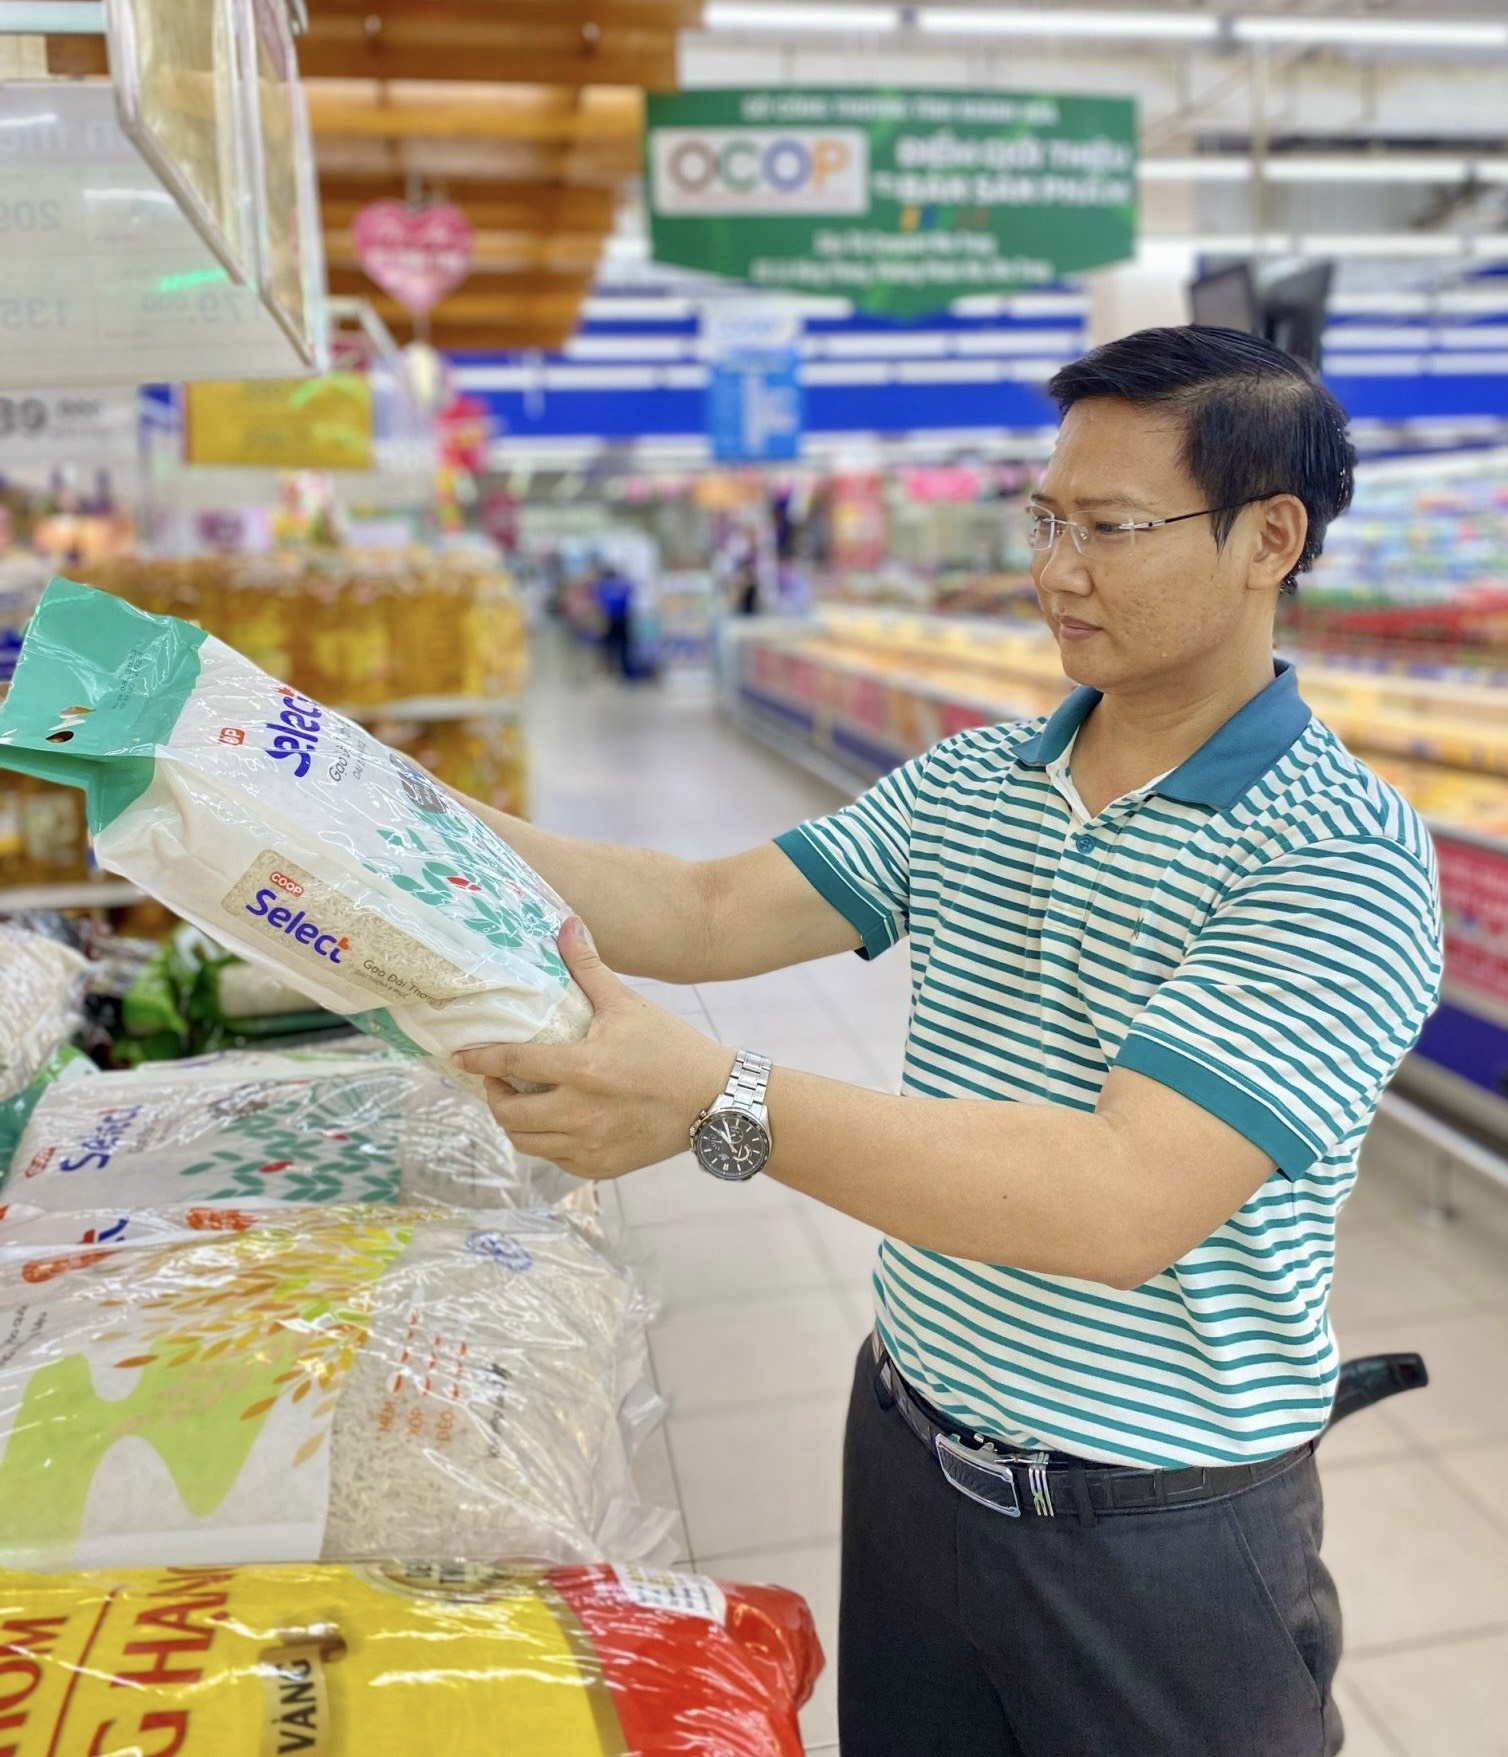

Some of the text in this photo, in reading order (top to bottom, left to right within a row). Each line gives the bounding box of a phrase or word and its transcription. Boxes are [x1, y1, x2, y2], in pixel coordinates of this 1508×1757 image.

[667, 139, 852, 195] OCOP
[271, 872, 304, 897] COOP
[246, 888, 350, 964] Select
[363, 959, 386, 979] Gạo
[408, 983, 434, 1002] Thơ
[271, 1656, 318, 1755] VÀNG
